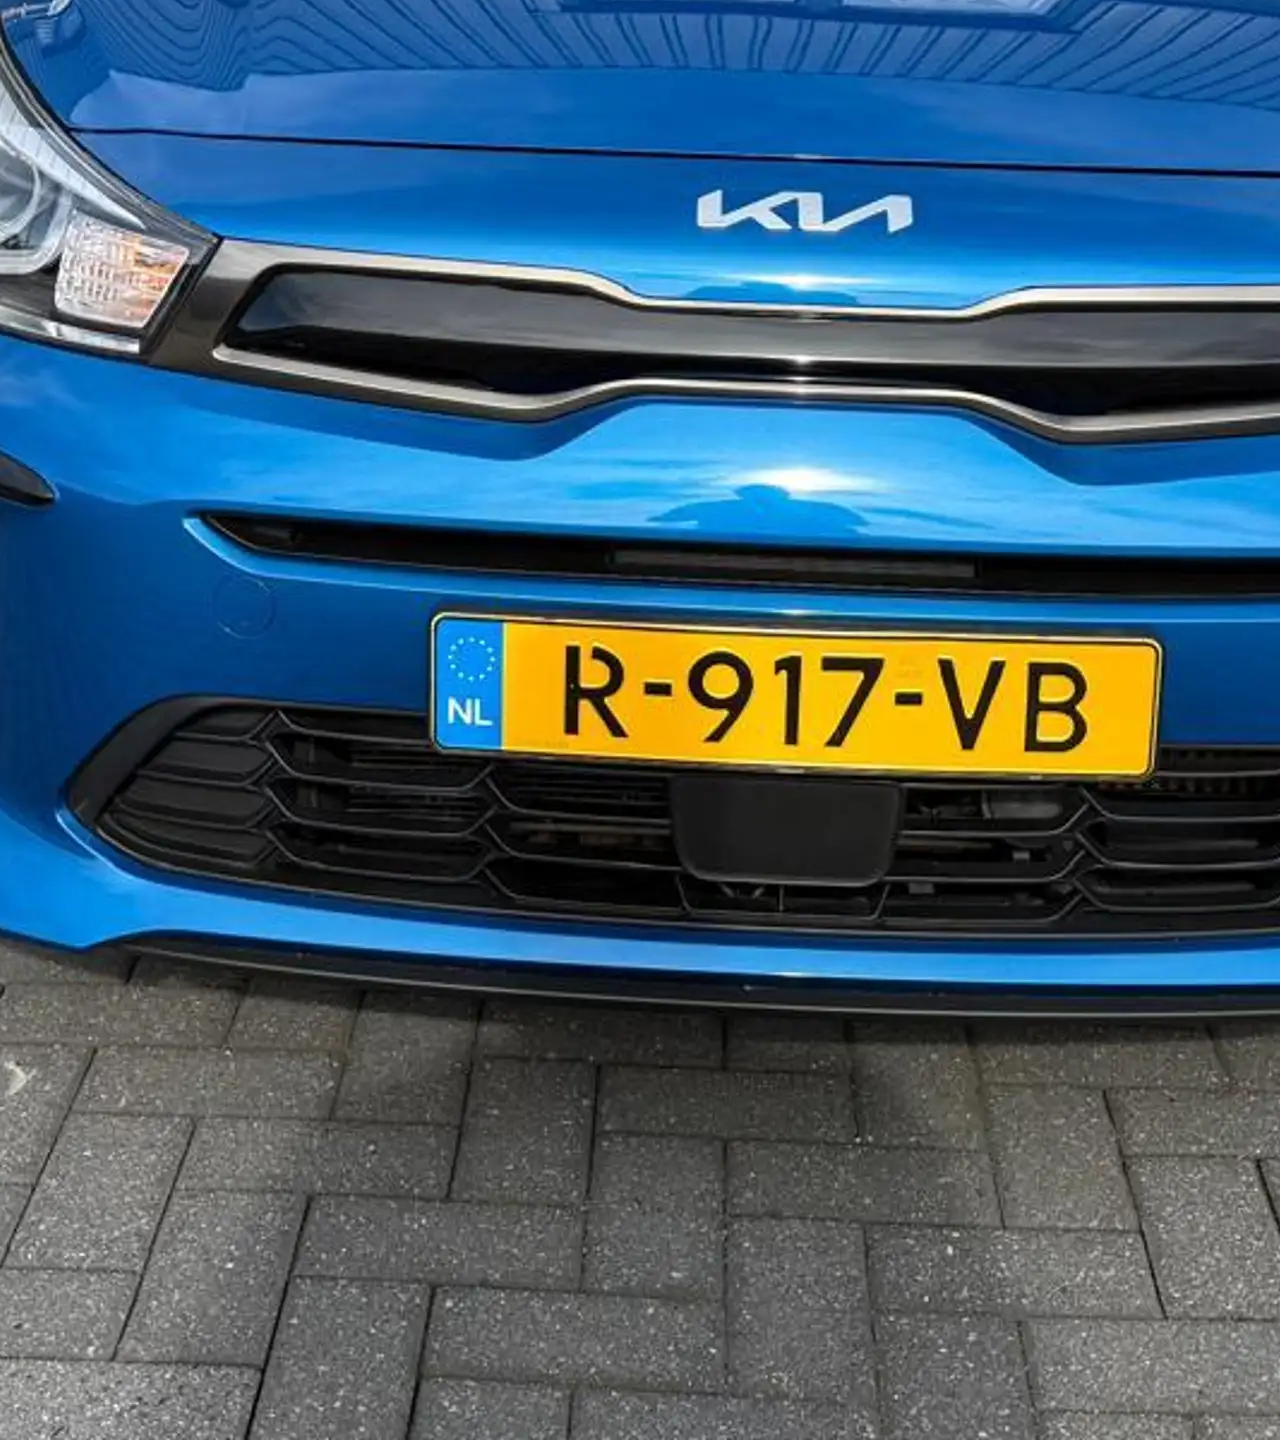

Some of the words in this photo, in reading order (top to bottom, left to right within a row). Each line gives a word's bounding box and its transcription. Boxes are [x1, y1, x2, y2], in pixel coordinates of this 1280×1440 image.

[696, 189, 913, 233] KIA
[448, 698, 493, 728] NL
[564, 644, 1089, 754] R-917-VB
